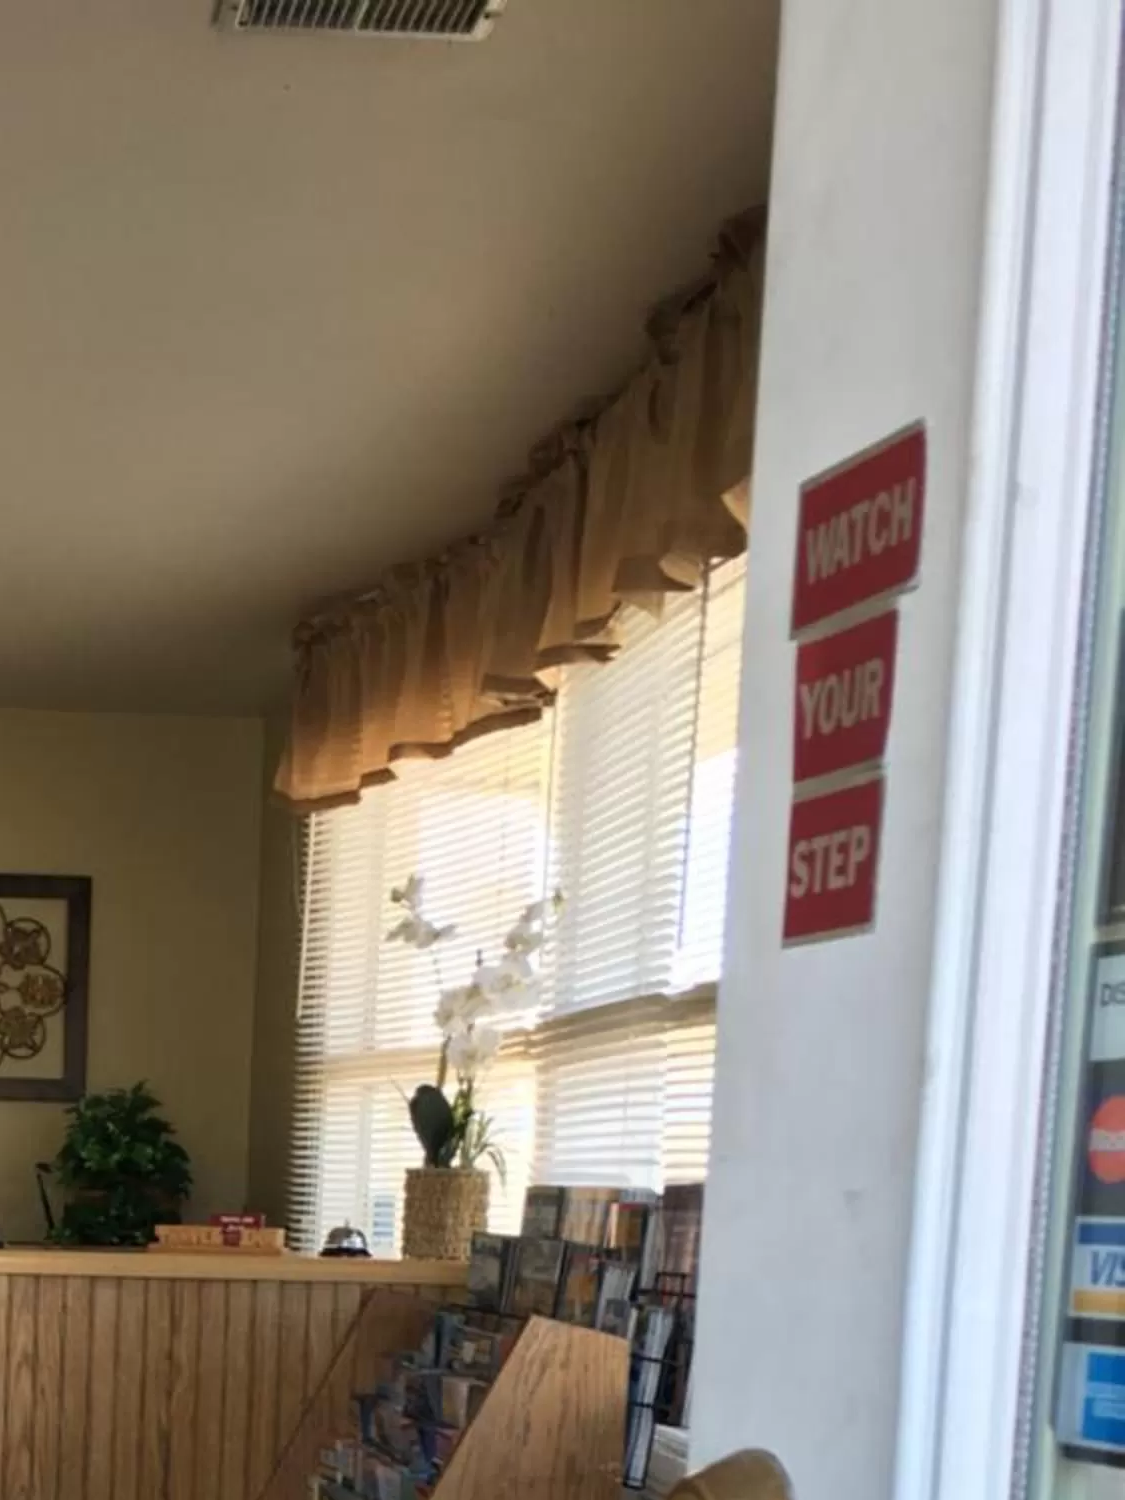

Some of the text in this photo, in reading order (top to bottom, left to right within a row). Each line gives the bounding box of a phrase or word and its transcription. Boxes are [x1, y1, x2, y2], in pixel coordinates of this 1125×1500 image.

[806, 477, 916, 584] WATCH
[799, 656, 884, 739] YOUR
[790, 825, 870, 898] STEP
